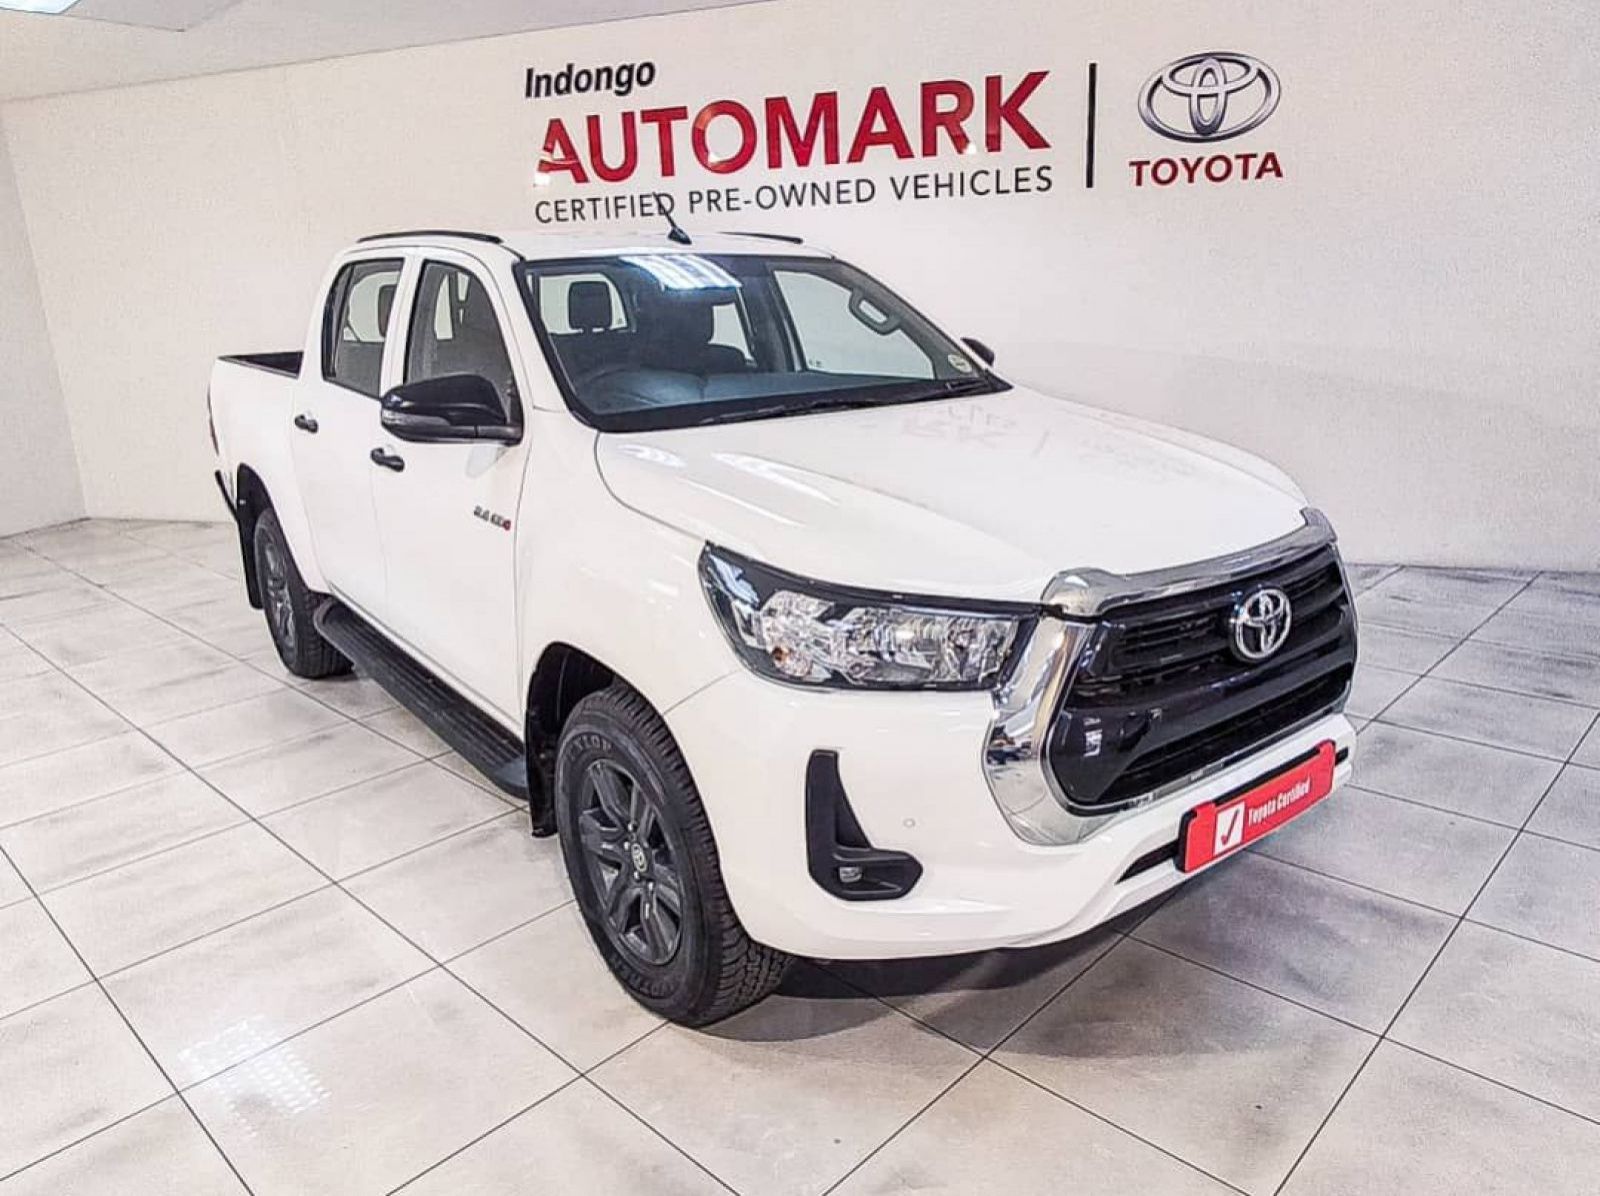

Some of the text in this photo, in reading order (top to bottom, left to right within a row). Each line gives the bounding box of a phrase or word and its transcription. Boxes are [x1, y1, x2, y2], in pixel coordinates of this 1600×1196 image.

[524, 62, 656, 99] Indongo
[536, 70, 1052, 184] AUTOMARK
[1128, 151, 1284, 187] TOYOTA
[534, 164, 1053, 224] CERTIFIED PRE-OWNED VEHICLES
[1248, 798, 1277, 827] Toyota
